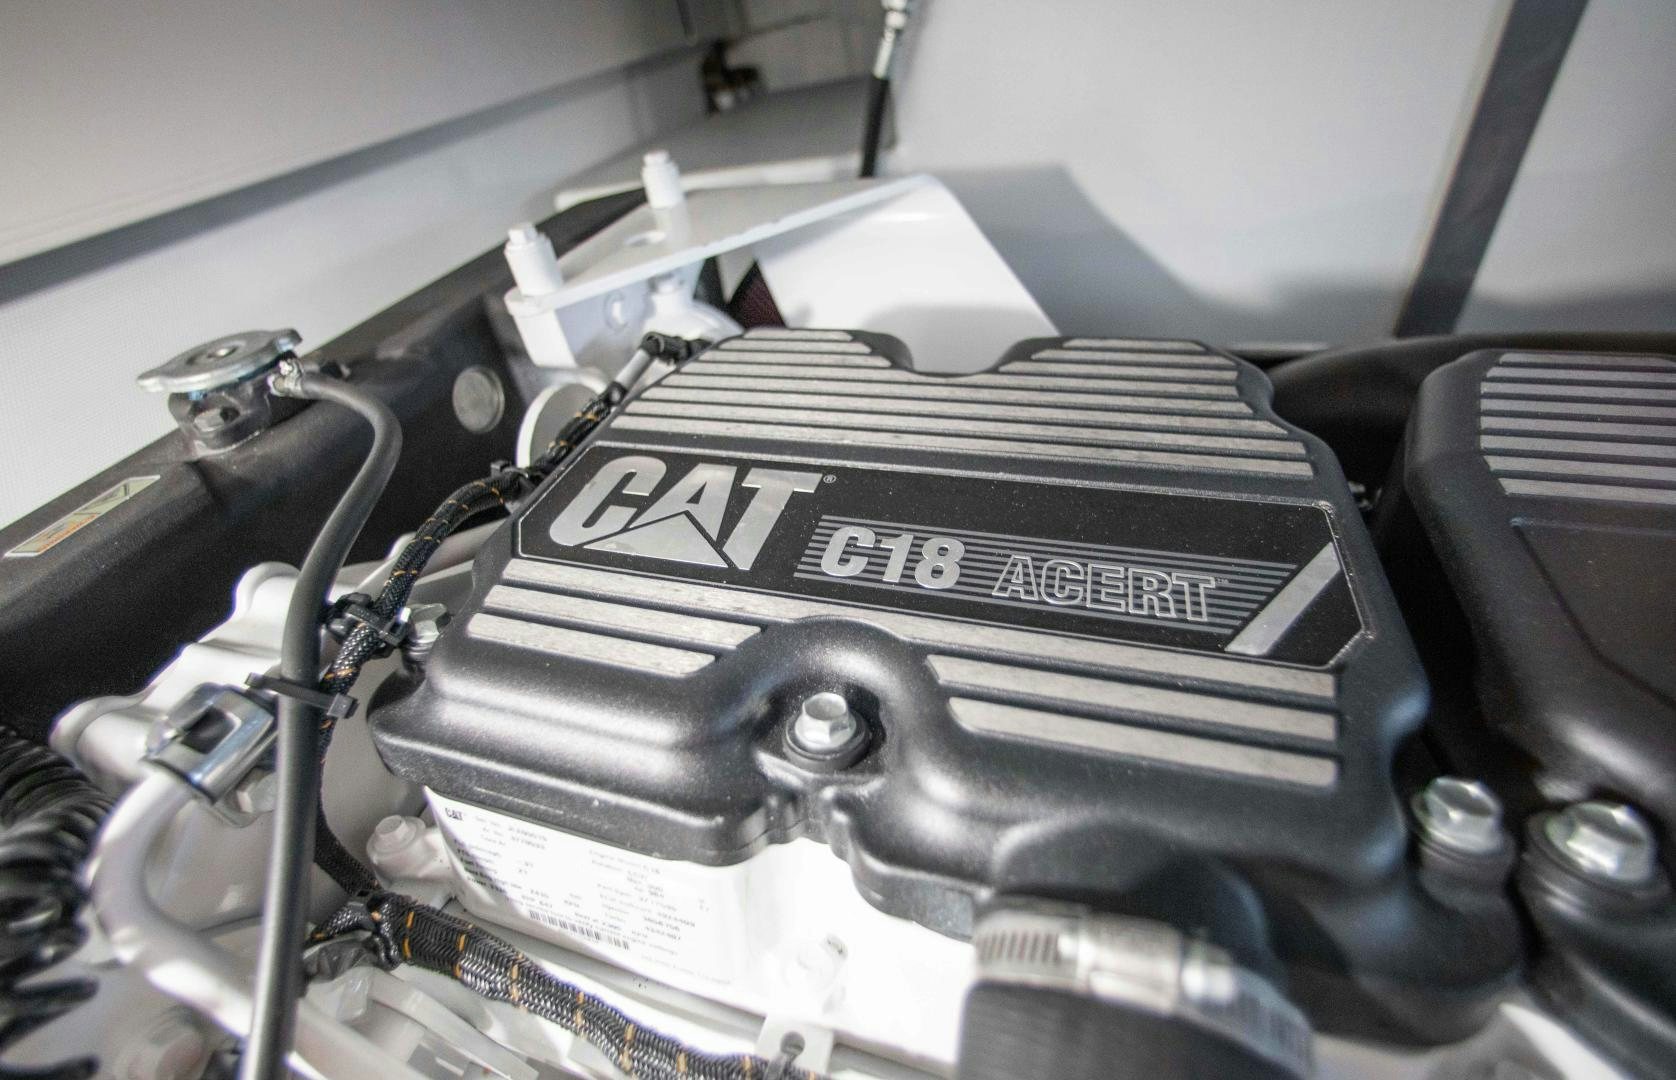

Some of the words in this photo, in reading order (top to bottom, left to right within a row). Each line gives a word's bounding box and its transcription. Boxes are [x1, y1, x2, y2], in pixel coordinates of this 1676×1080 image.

[550, 456, 822, 570] CAT
[821, 526, 965, 589] C18
[992, 555, 1217, 621] ACERT
[445, 807, 463, 821] CAT
